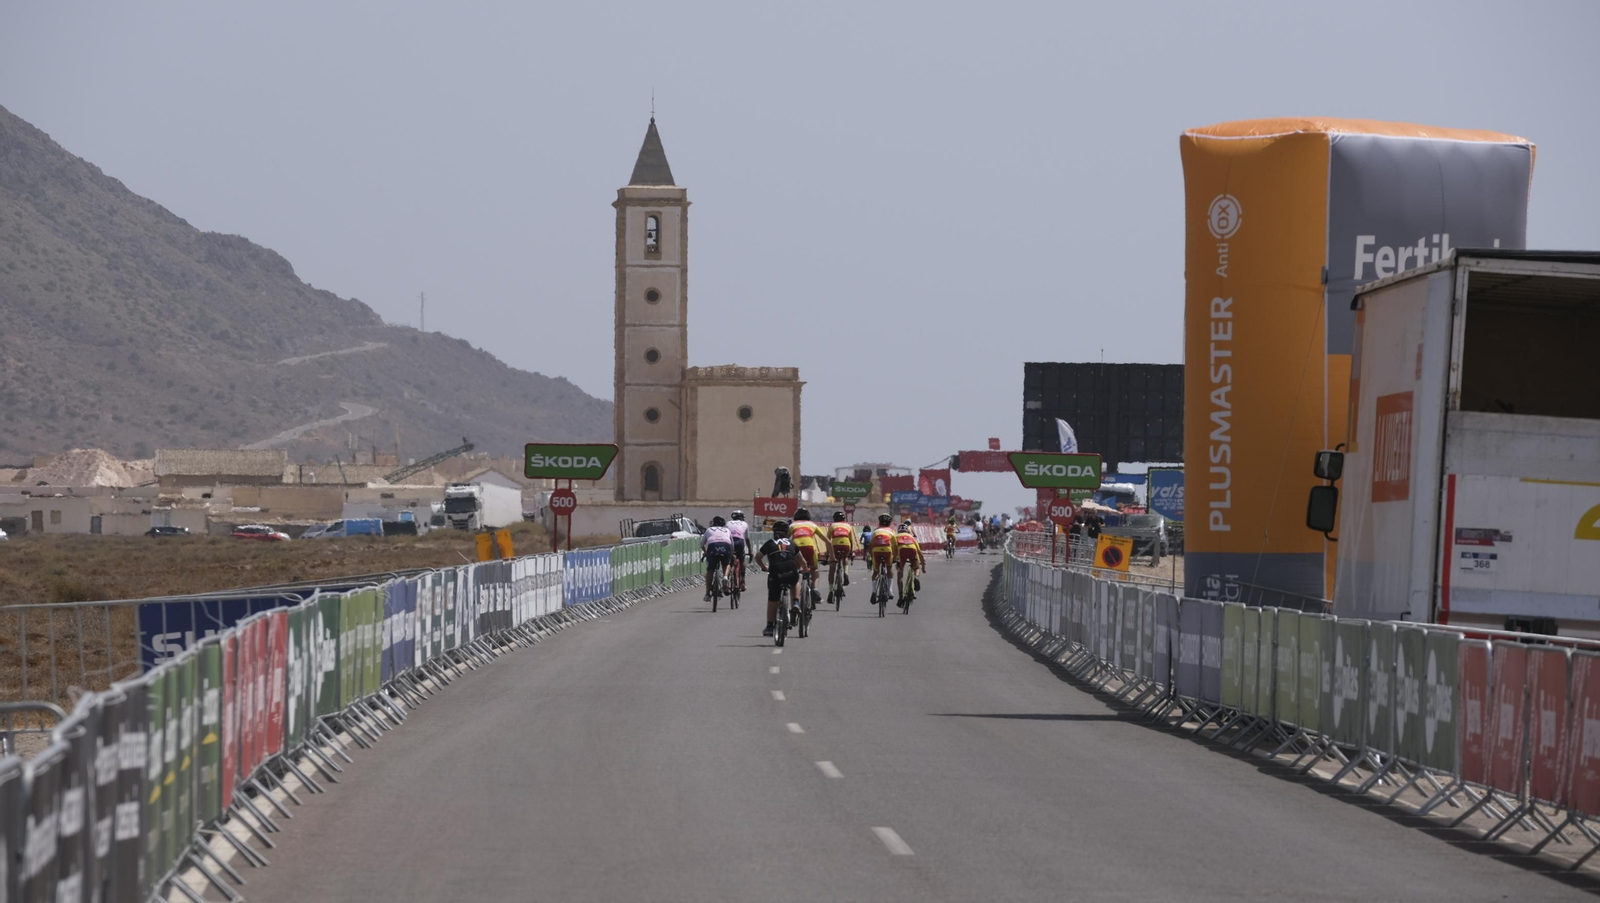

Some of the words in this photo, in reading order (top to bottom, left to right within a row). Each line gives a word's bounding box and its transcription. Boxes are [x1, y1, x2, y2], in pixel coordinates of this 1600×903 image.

[1217, 203, 1230, 230] OX
[1216, 242, 1229, 278] Anti
[1209, 295, 1233, 532] PLUSMASTER
[531, 453, 602, 468] ŠKODA
[1024, 461, 1096, 477] ŠKODA
[552, 496, 574, 508] 500
[764, 501, 788, 514] rtve
[1051, 506, 1073, 518] 500
[1473, 559, 1491, 569] 368
